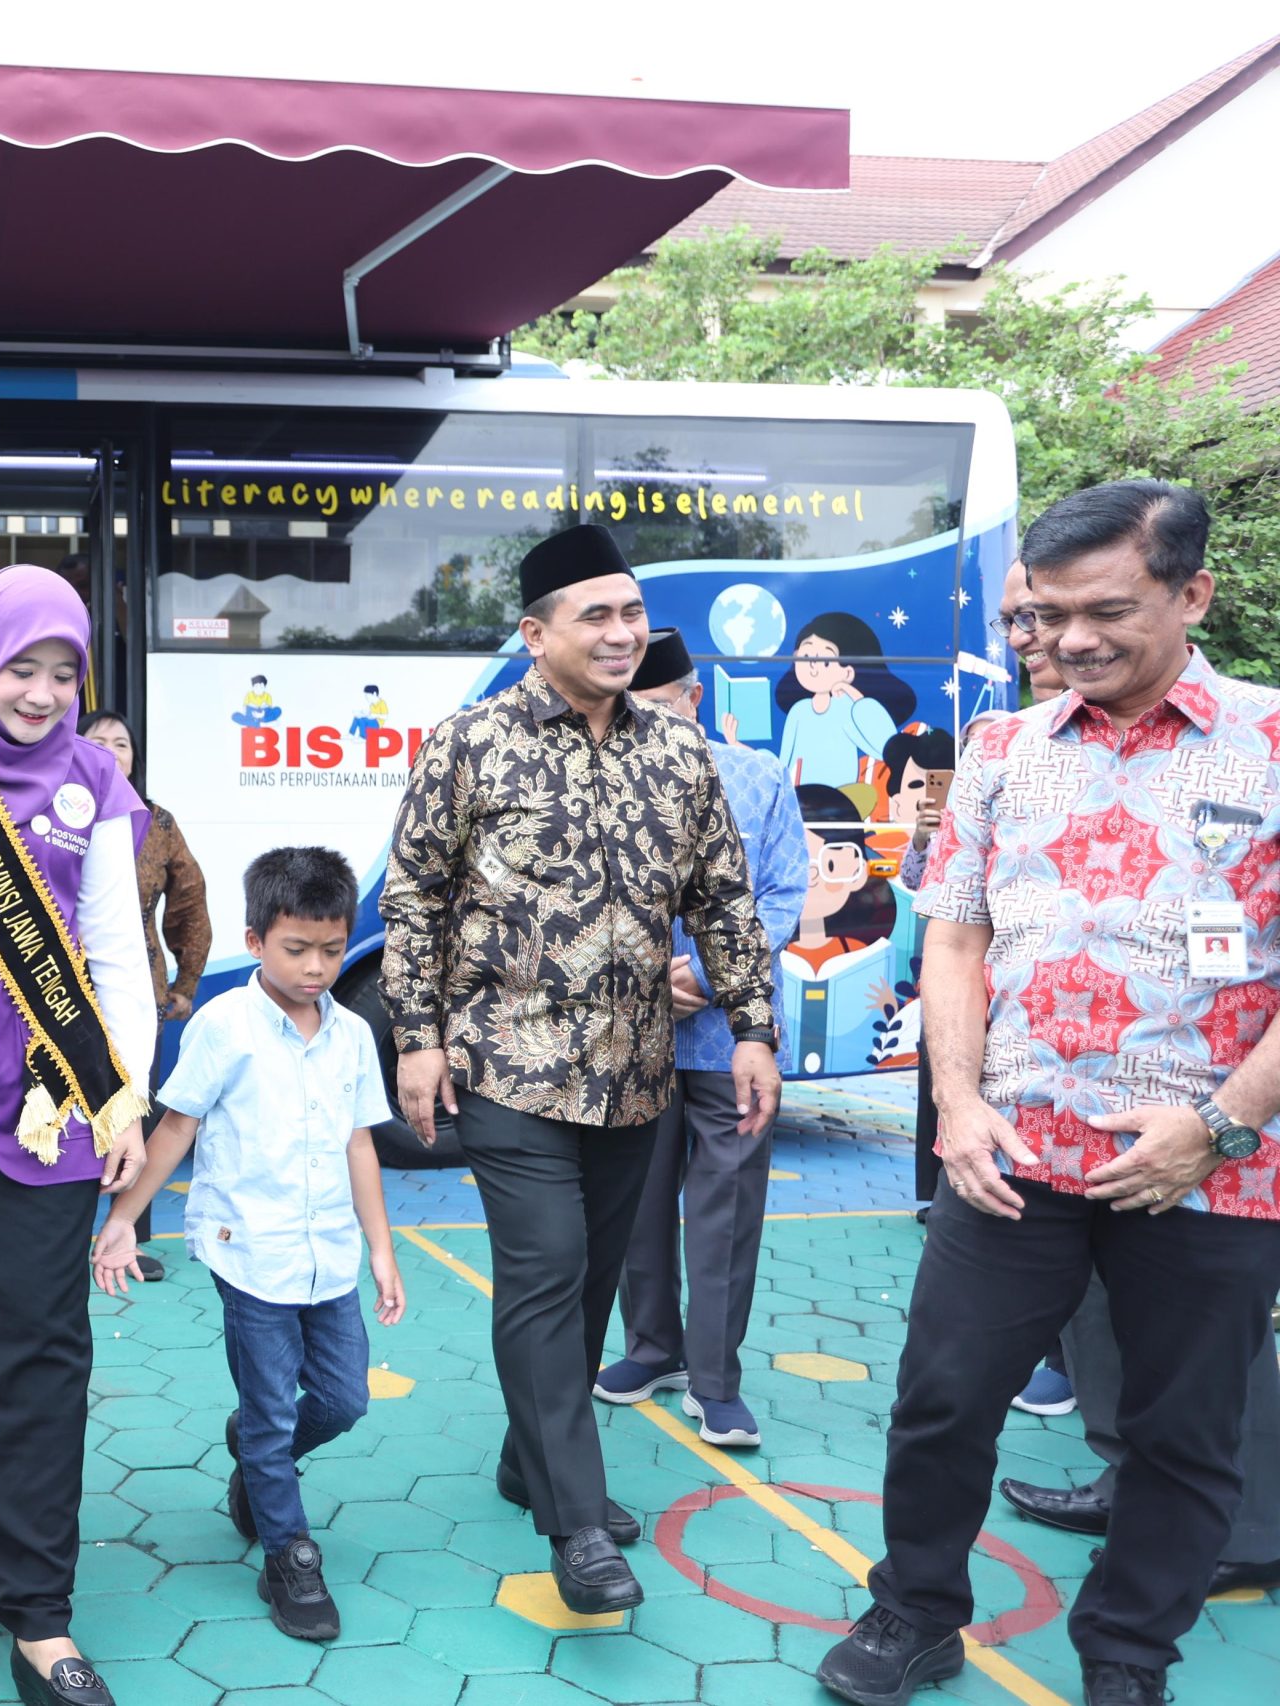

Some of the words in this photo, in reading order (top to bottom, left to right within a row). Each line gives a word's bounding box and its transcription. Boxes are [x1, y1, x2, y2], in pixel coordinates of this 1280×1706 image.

[350, 481, 466, 510] where
[476, 484, 624, 521] reading
[637, 486, 665, 515] is
[676, 486, 863, 522] elemental
[241, 726, 344, 769] BIS
[239, 772, 276, 787] DINAS
[280, 772, 377, 788] PERPUSTAKAAN
[381, 773, 406, 788] DAN
[44, 835, 51, 843] 6
[52, 837, 80, 854] BIDANG
[3, 909, 45, 963] JAWA
[31, 954, 81, 1027] TENGAH
